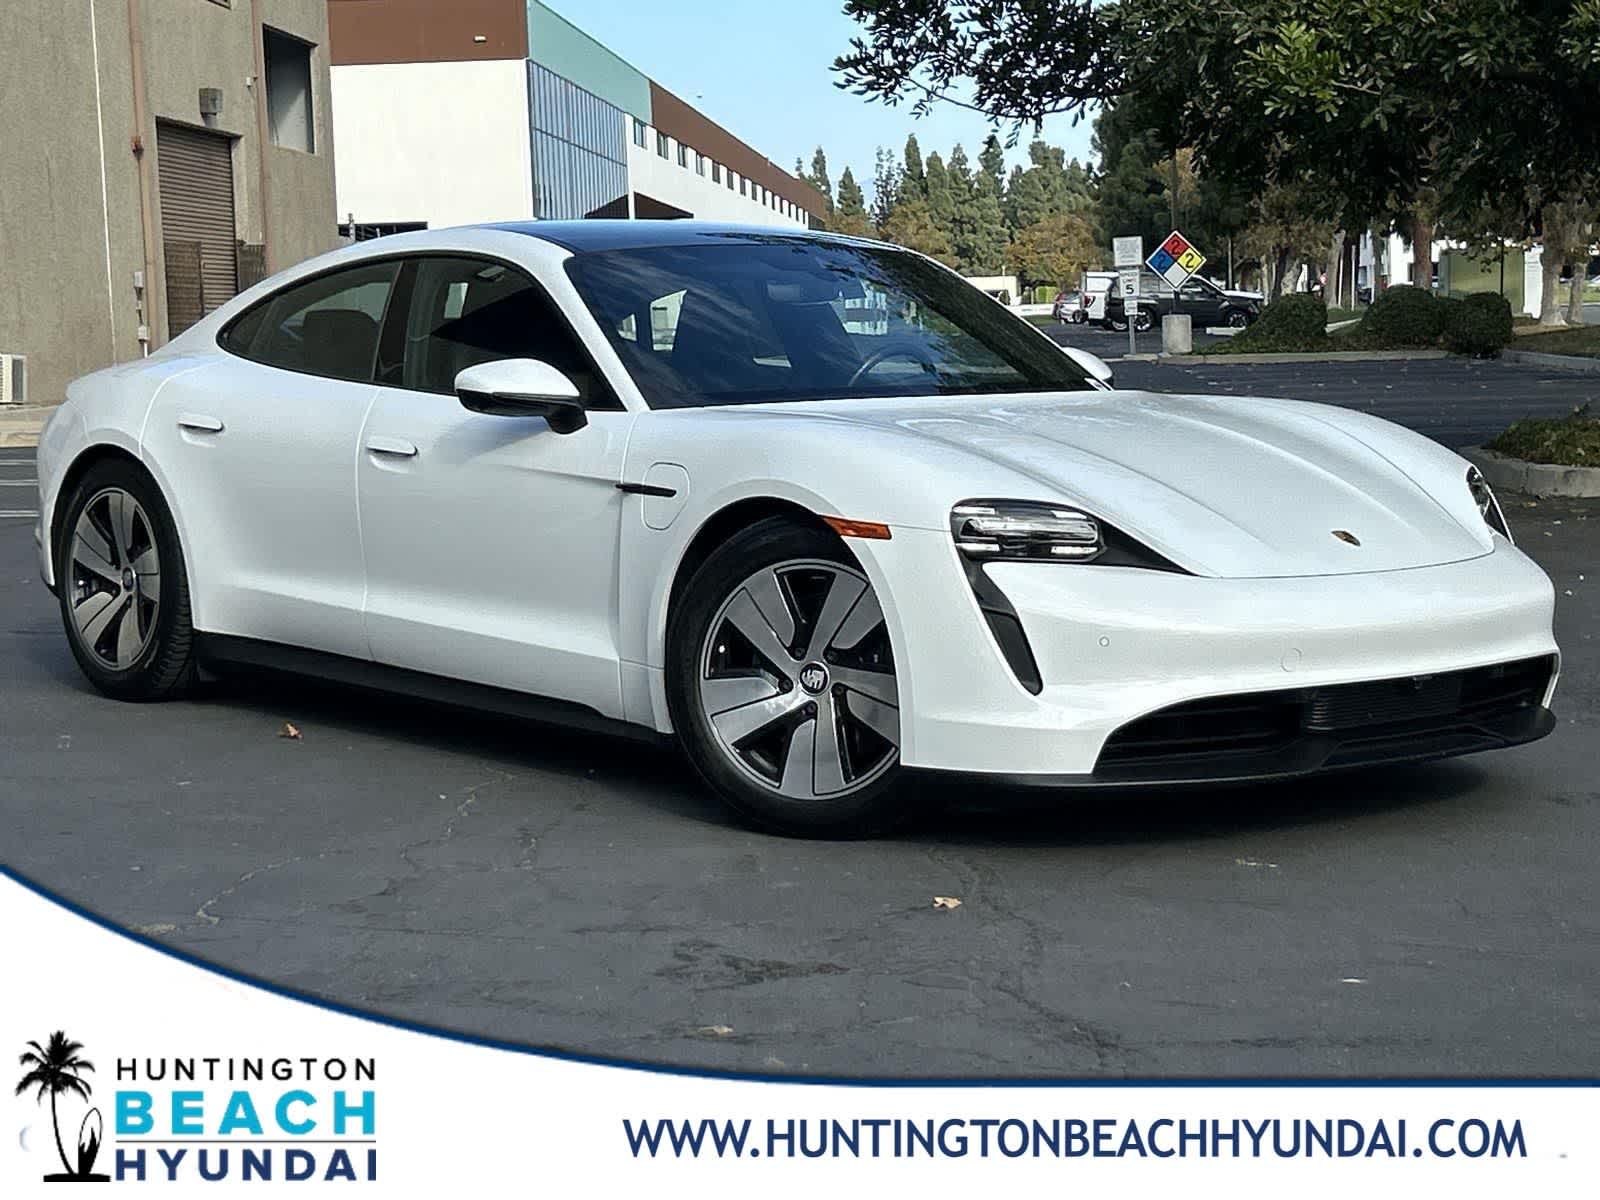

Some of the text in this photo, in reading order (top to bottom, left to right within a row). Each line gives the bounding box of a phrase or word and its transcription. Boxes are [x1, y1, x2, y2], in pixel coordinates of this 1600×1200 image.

[1171, 239, 1181, 255] 2
[1158, 254, 1167, 269] 2
[1185, 253, 1194, 268] 2
[1126, 284, 1135, 294] 5
